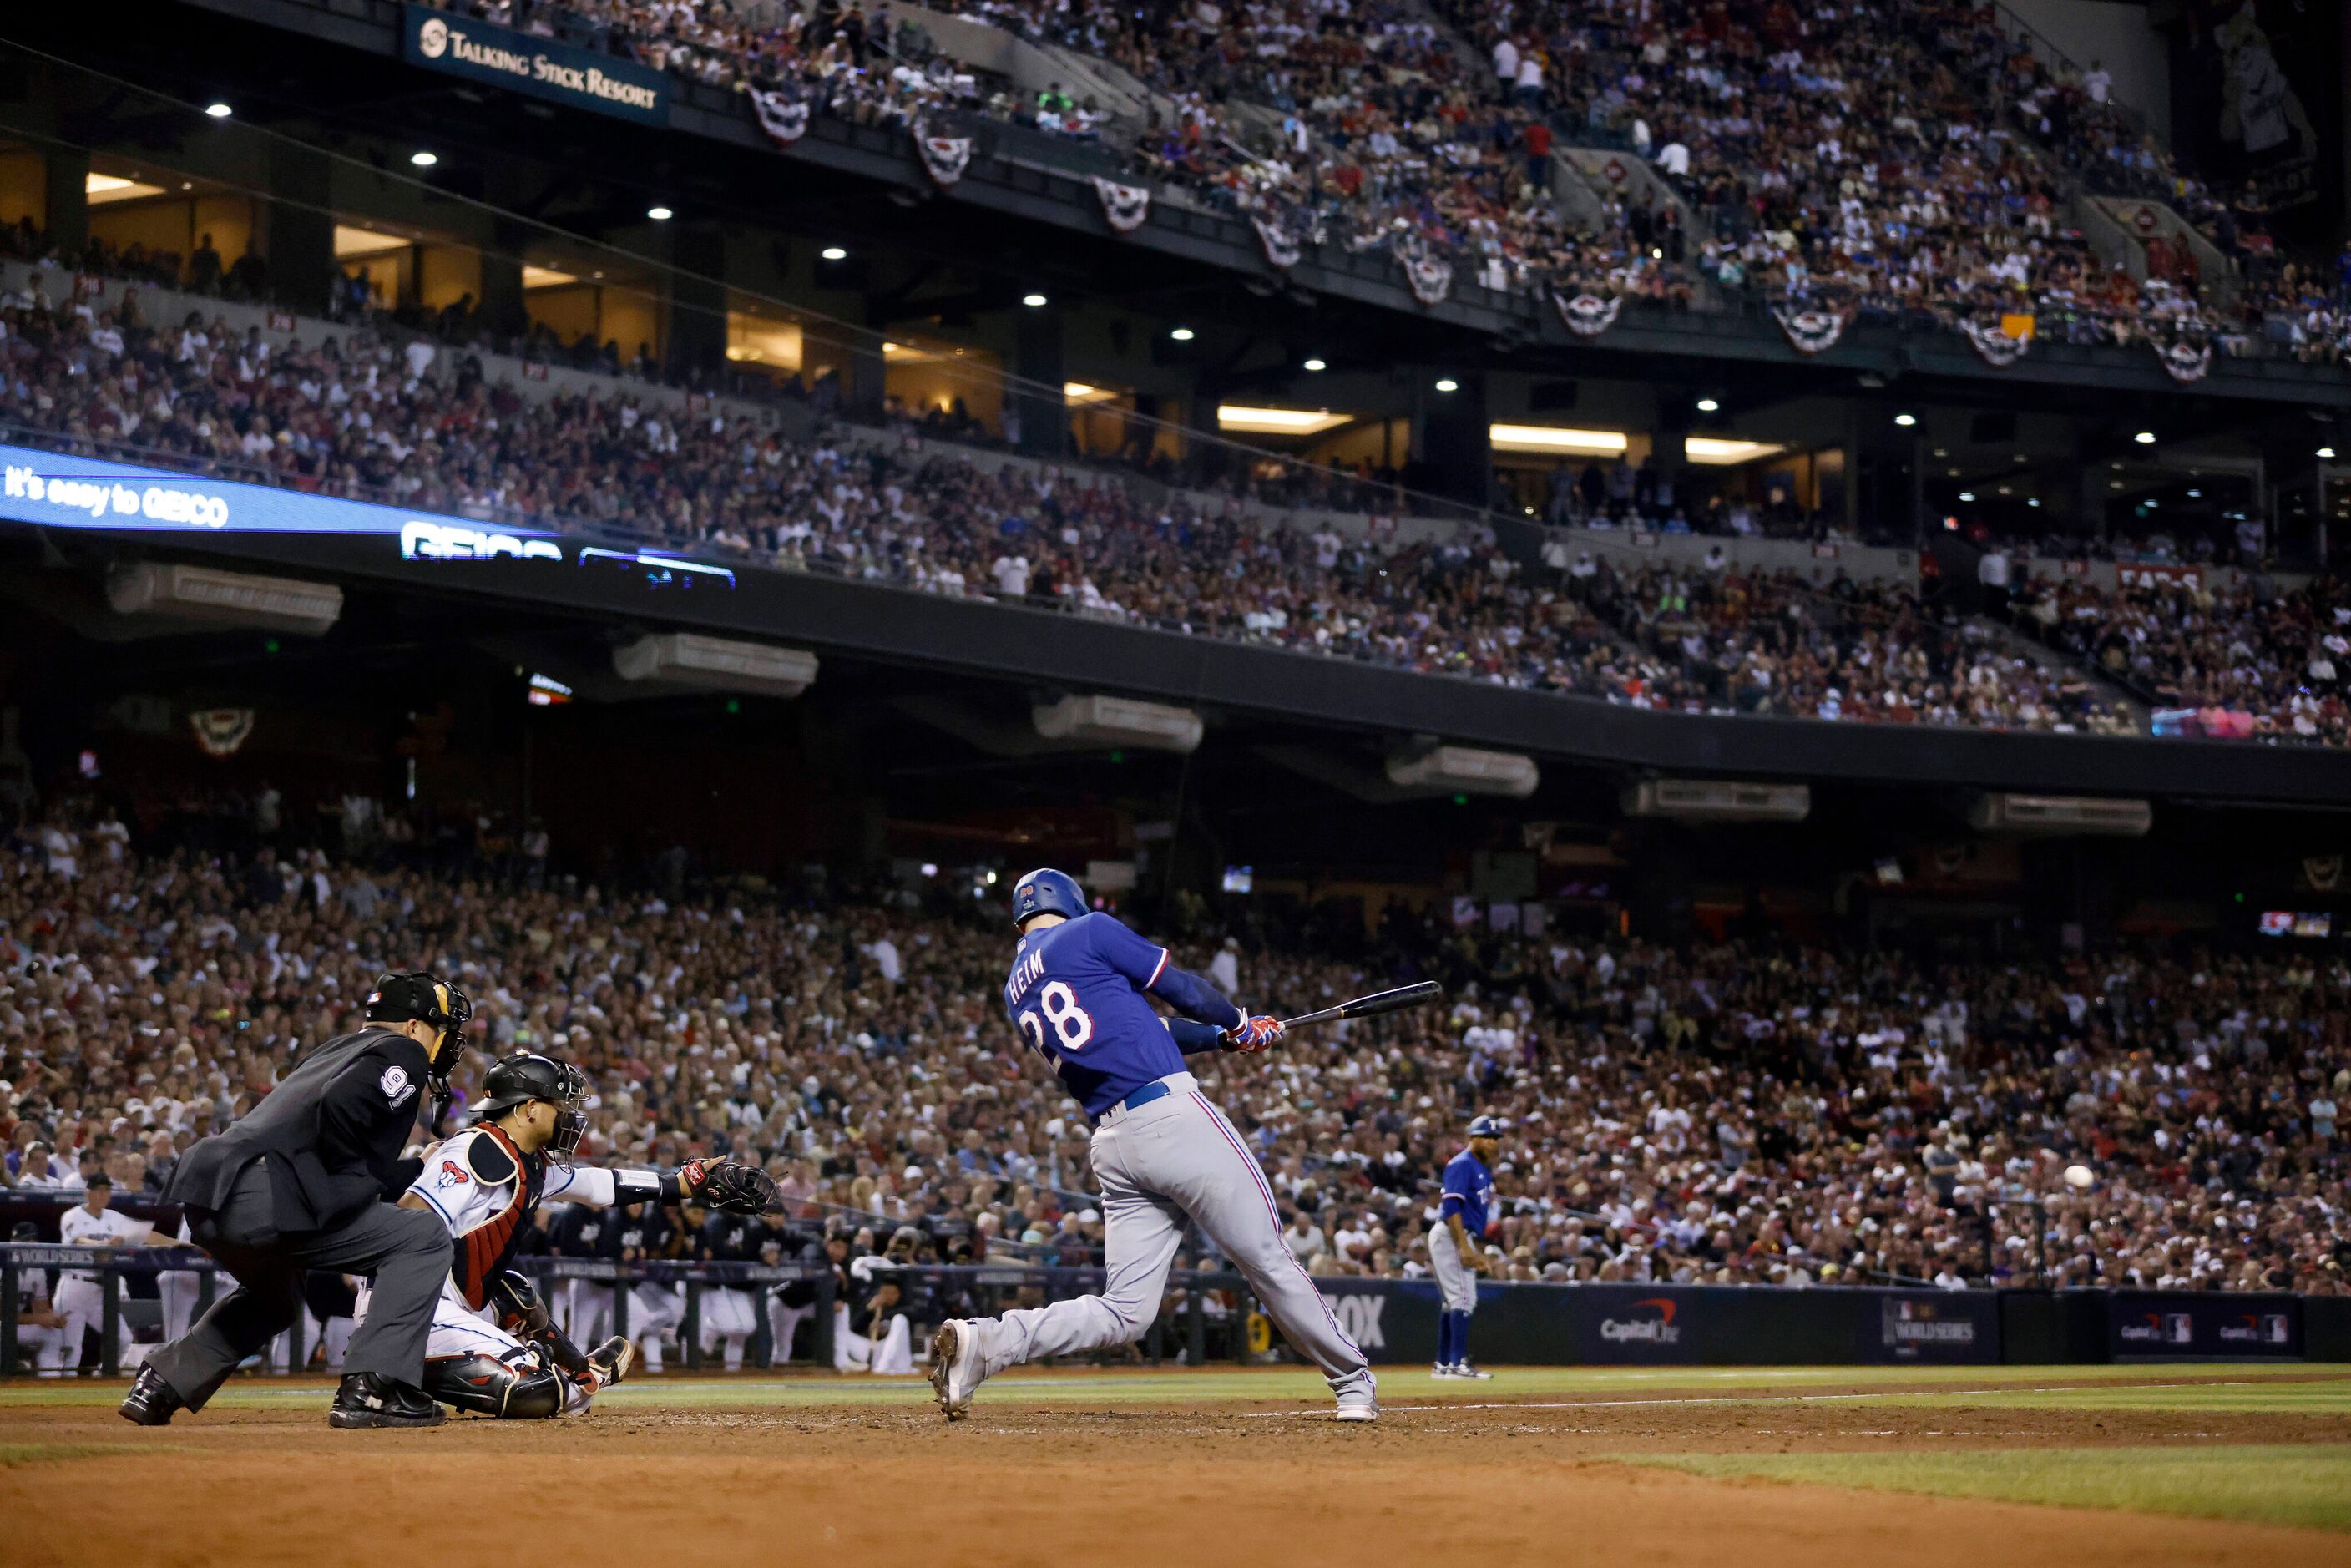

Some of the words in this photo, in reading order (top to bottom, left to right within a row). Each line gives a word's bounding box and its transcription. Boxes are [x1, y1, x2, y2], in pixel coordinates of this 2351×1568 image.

[5, 466, 45, 500] It's
[48, 479, 110, 518] easy
[111, 483, 139, 515] to
[142, 487, 229, 528] GEICO
[1009, 948, 1044, 1005] HEIM
[1019, 980, 1096, 1075] 28
[381, 1065, 417, 1110] 91
